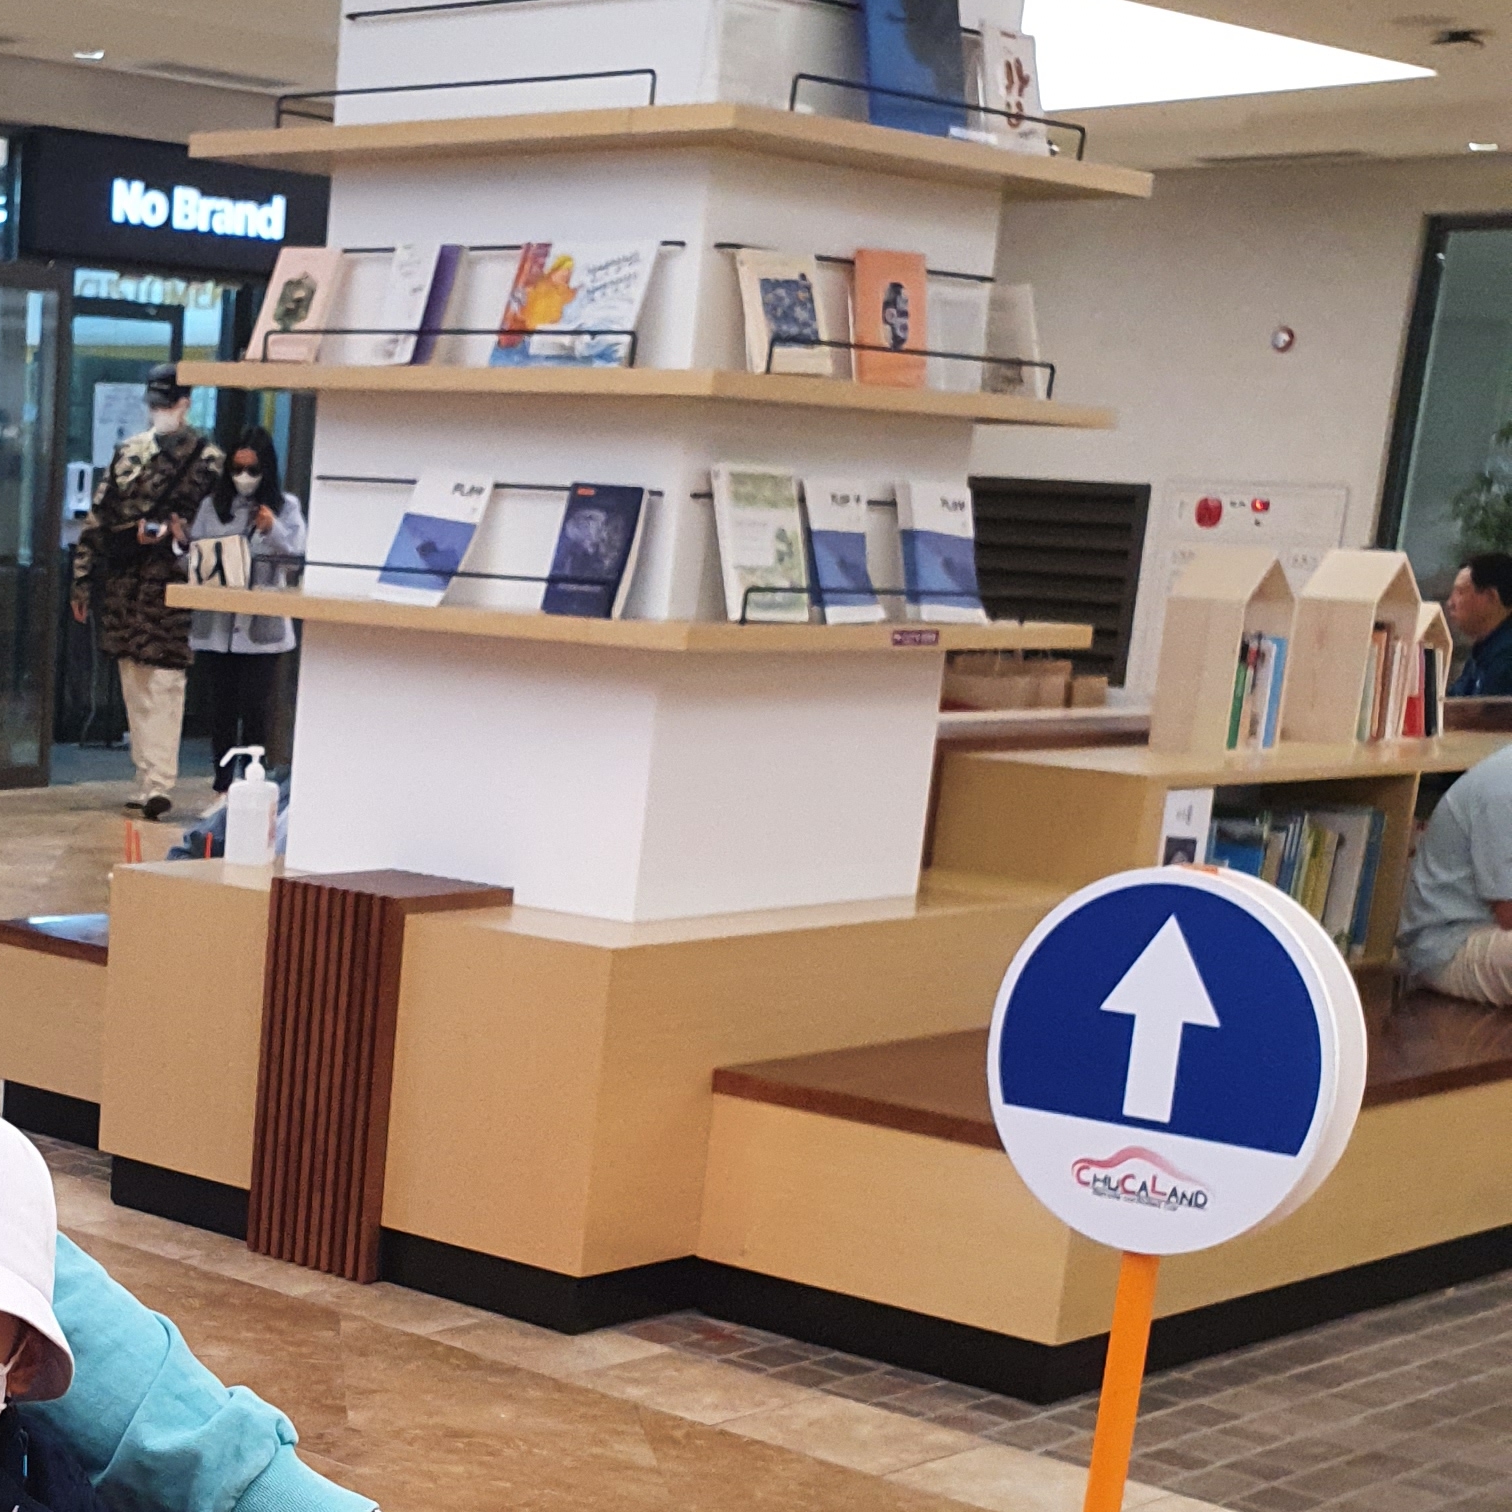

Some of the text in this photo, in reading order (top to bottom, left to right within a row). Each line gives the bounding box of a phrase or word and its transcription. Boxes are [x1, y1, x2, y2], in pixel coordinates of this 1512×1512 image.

[112, 177, 287, 241] No Brand
[1074, 1163, 1209, 1210] CHUCALAND
